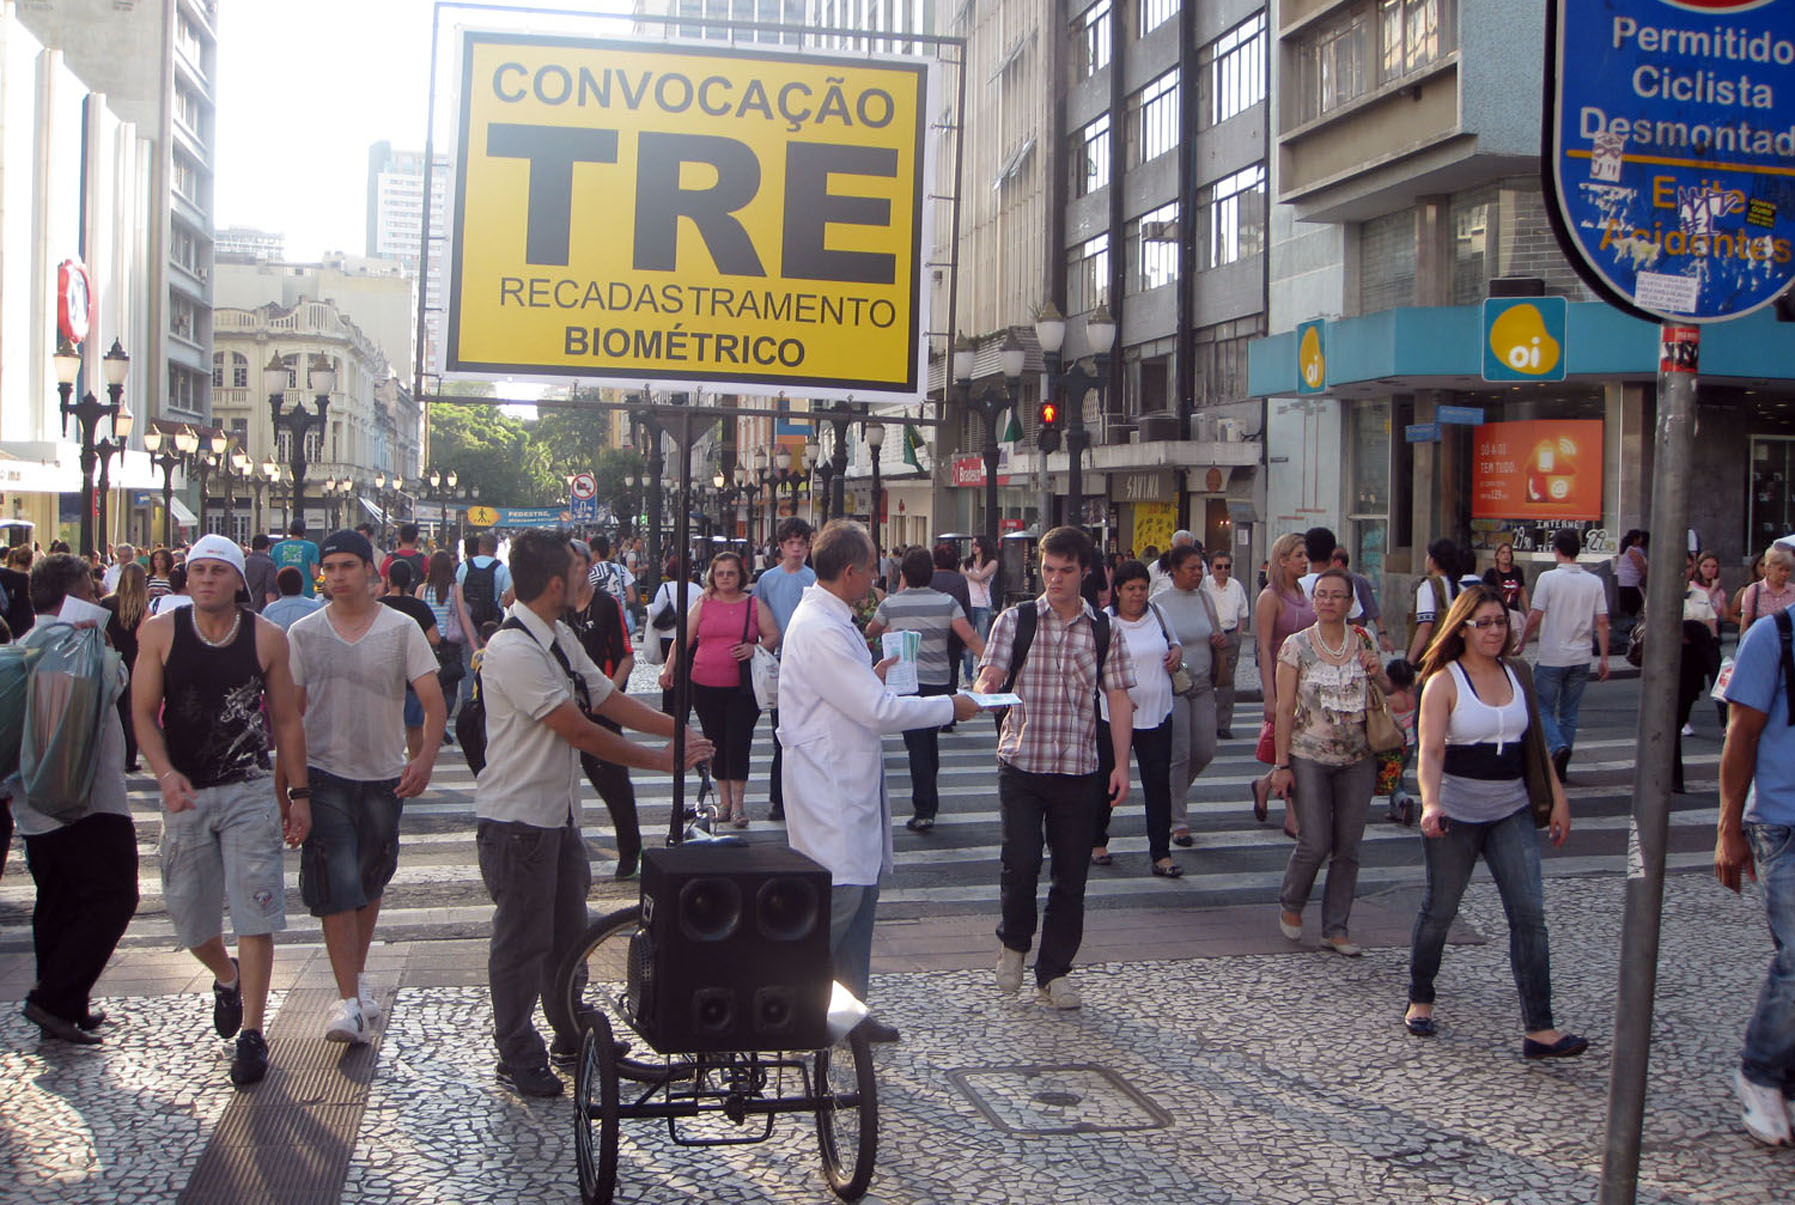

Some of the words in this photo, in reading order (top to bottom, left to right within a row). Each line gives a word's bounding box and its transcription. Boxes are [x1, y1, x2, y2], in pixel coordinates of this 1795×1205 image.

[1612, 16, 1795, 65] Permitido
[492, 61, 896, 133] CONVOCAÇÃO
[1632, 65, 1773, 109] Ciclista
[486, 122, 899, 285] TRE
[1653, 175, 1746, 214] Eite
[500, 276, 896, 329] RECADASTRAMENTO
[563, 322, 806, 367] BIOMÉTRICO
[1508, 336, 1540, 368] oi
[1306, 354, 1318, 382] oi
[959, 466, 981, 482] Bradesc
[1127, 474, 1159, 499] SAVINA
[1480, 461, 1494, 474] TEM
[1536, 520, 1585, 530] INTERNET
